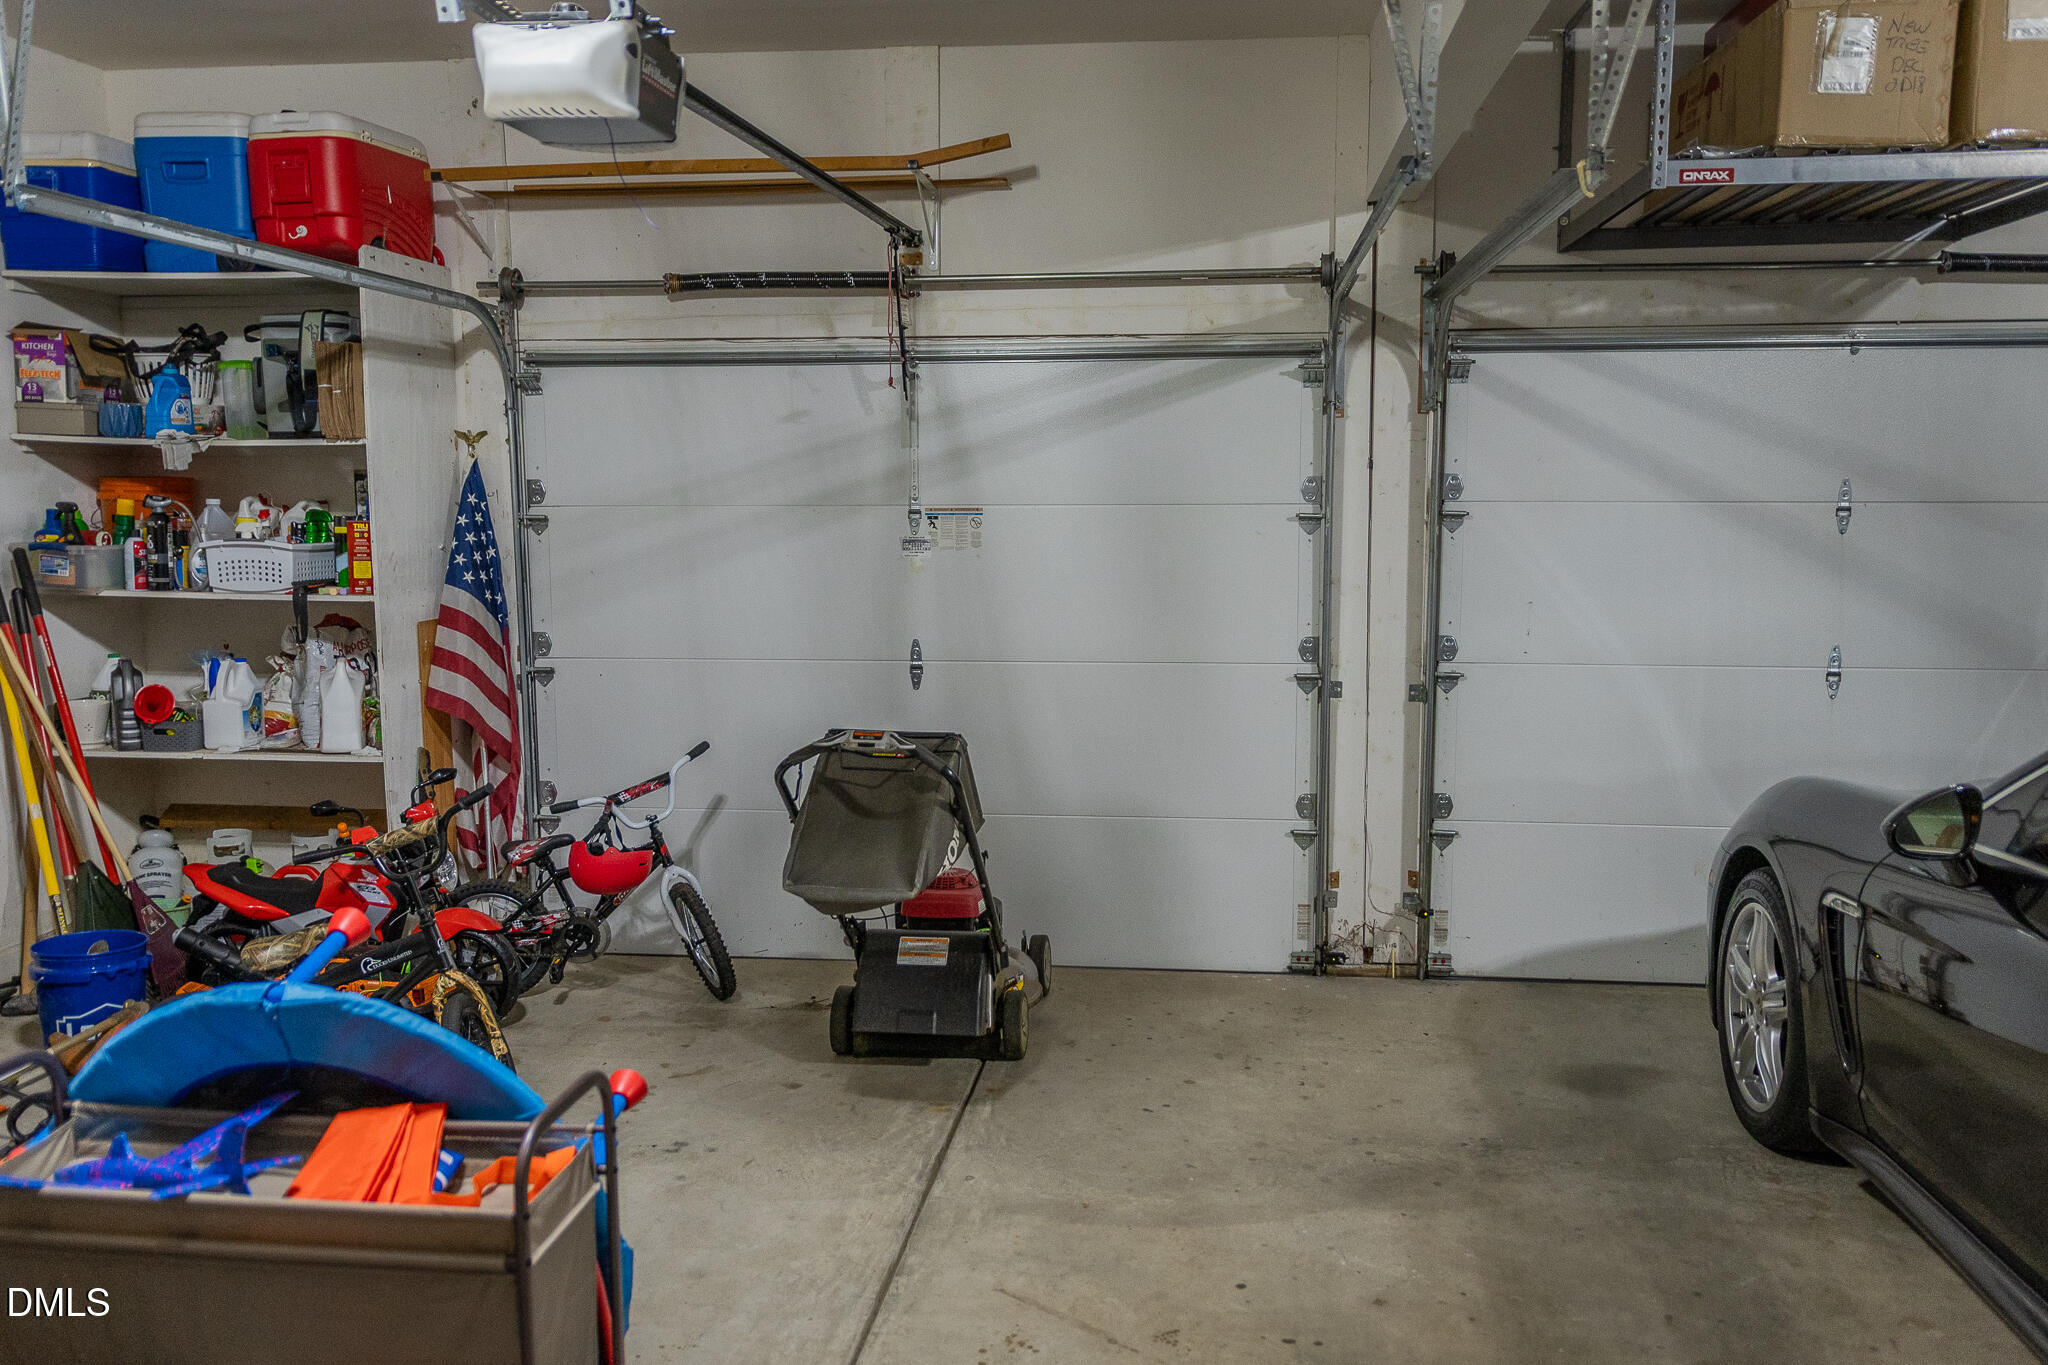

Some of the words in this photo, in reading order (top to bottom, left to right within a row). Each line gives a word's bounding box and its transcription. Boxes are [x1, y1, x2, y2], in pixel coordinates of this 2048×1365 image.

[1887, 12, 1932, 35] NEW
[1682, 170, 1731, 182] ONRAX
[21, 341, 54, 351] KITCHEN
[27, 382, 37, 391] 13
